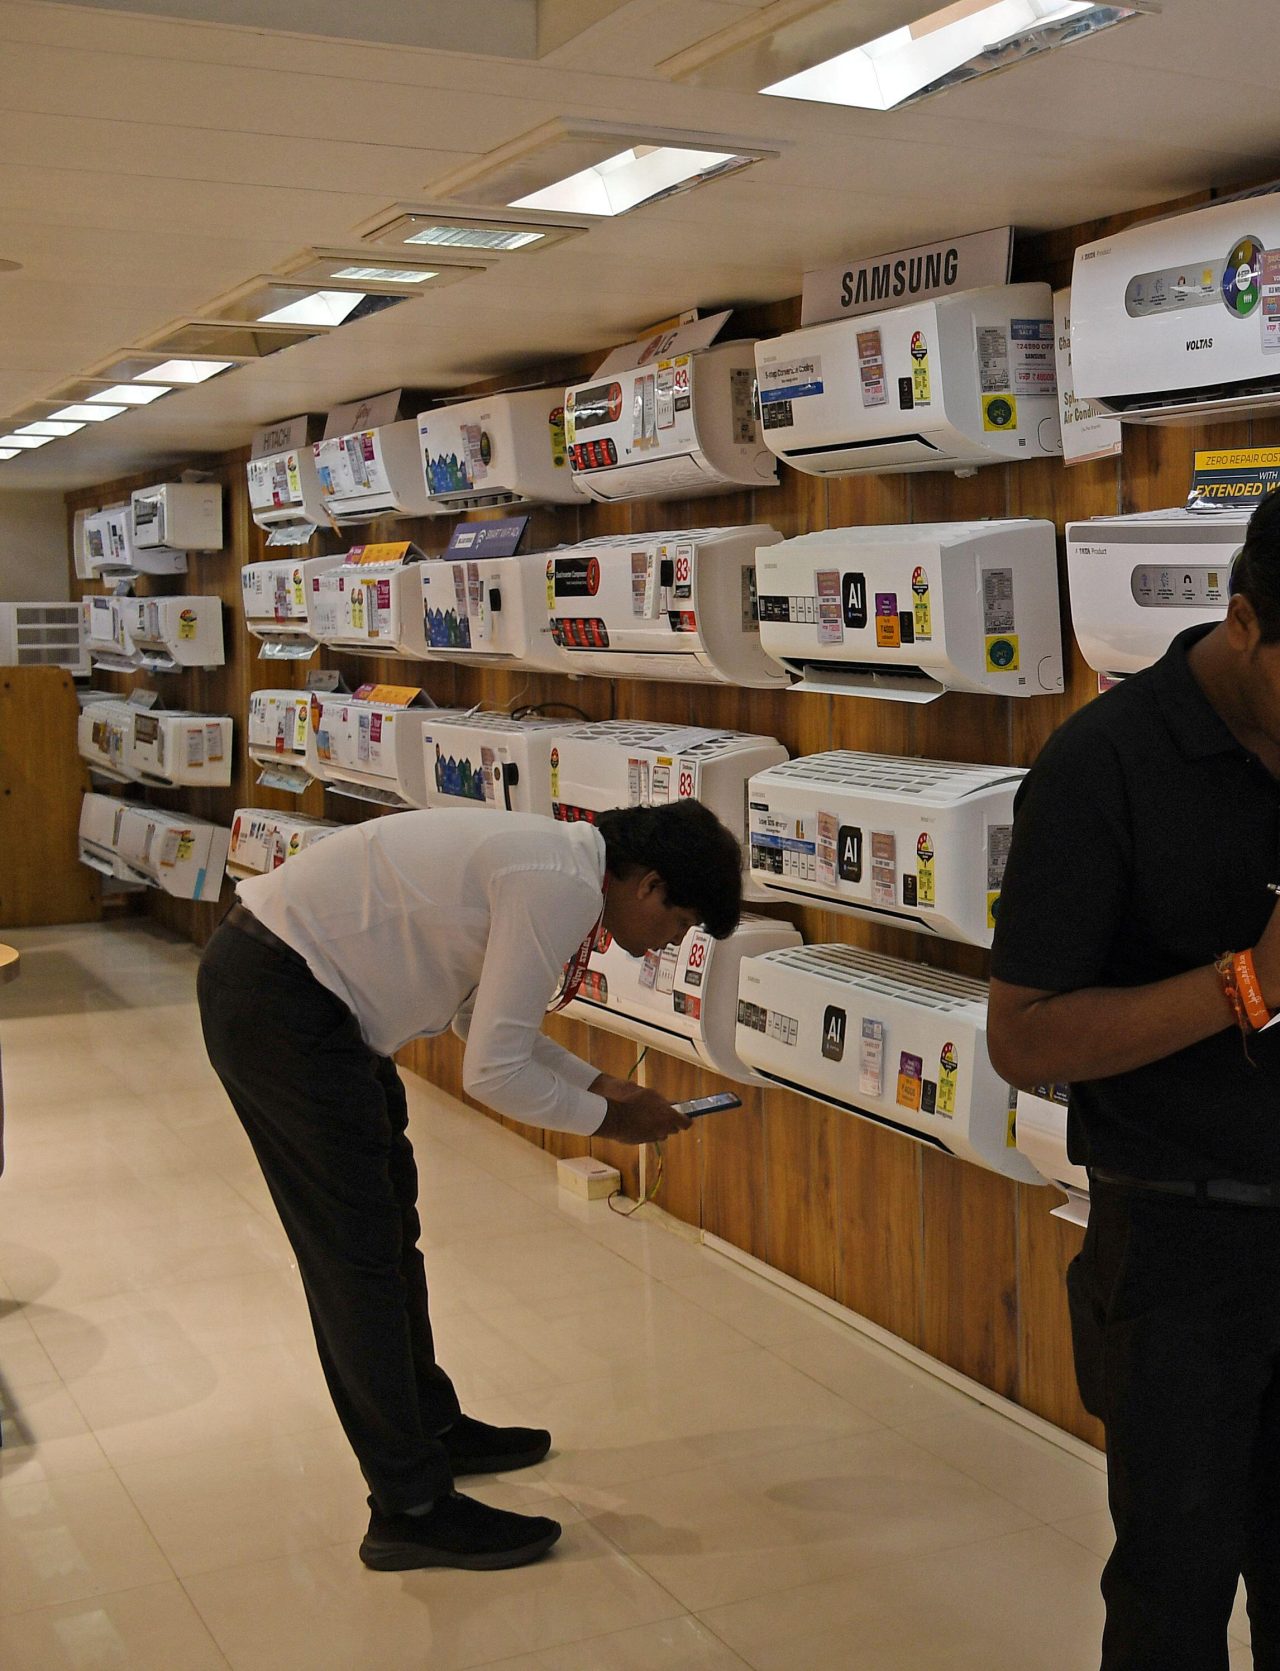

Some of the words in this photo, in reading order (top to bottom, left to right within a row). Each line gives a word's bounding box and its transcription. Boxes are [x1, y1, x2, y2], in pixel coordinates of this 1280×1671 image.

[841, 249, 958, 307] SAMSUNG
[1186, 338, 1214, 351] VOLTAS
[1206, 455, 1228, 466] ZERO
[1229, 454, 1259, 464] REPAIR
[1258, 471, 1278, 480] WITH
[1196, 483, 1263, 498] EXTENDED
[849, 583, 862, 609] AI
[843, 836, 858, 863] AI
[826, 1016, 842, 1043] AI
